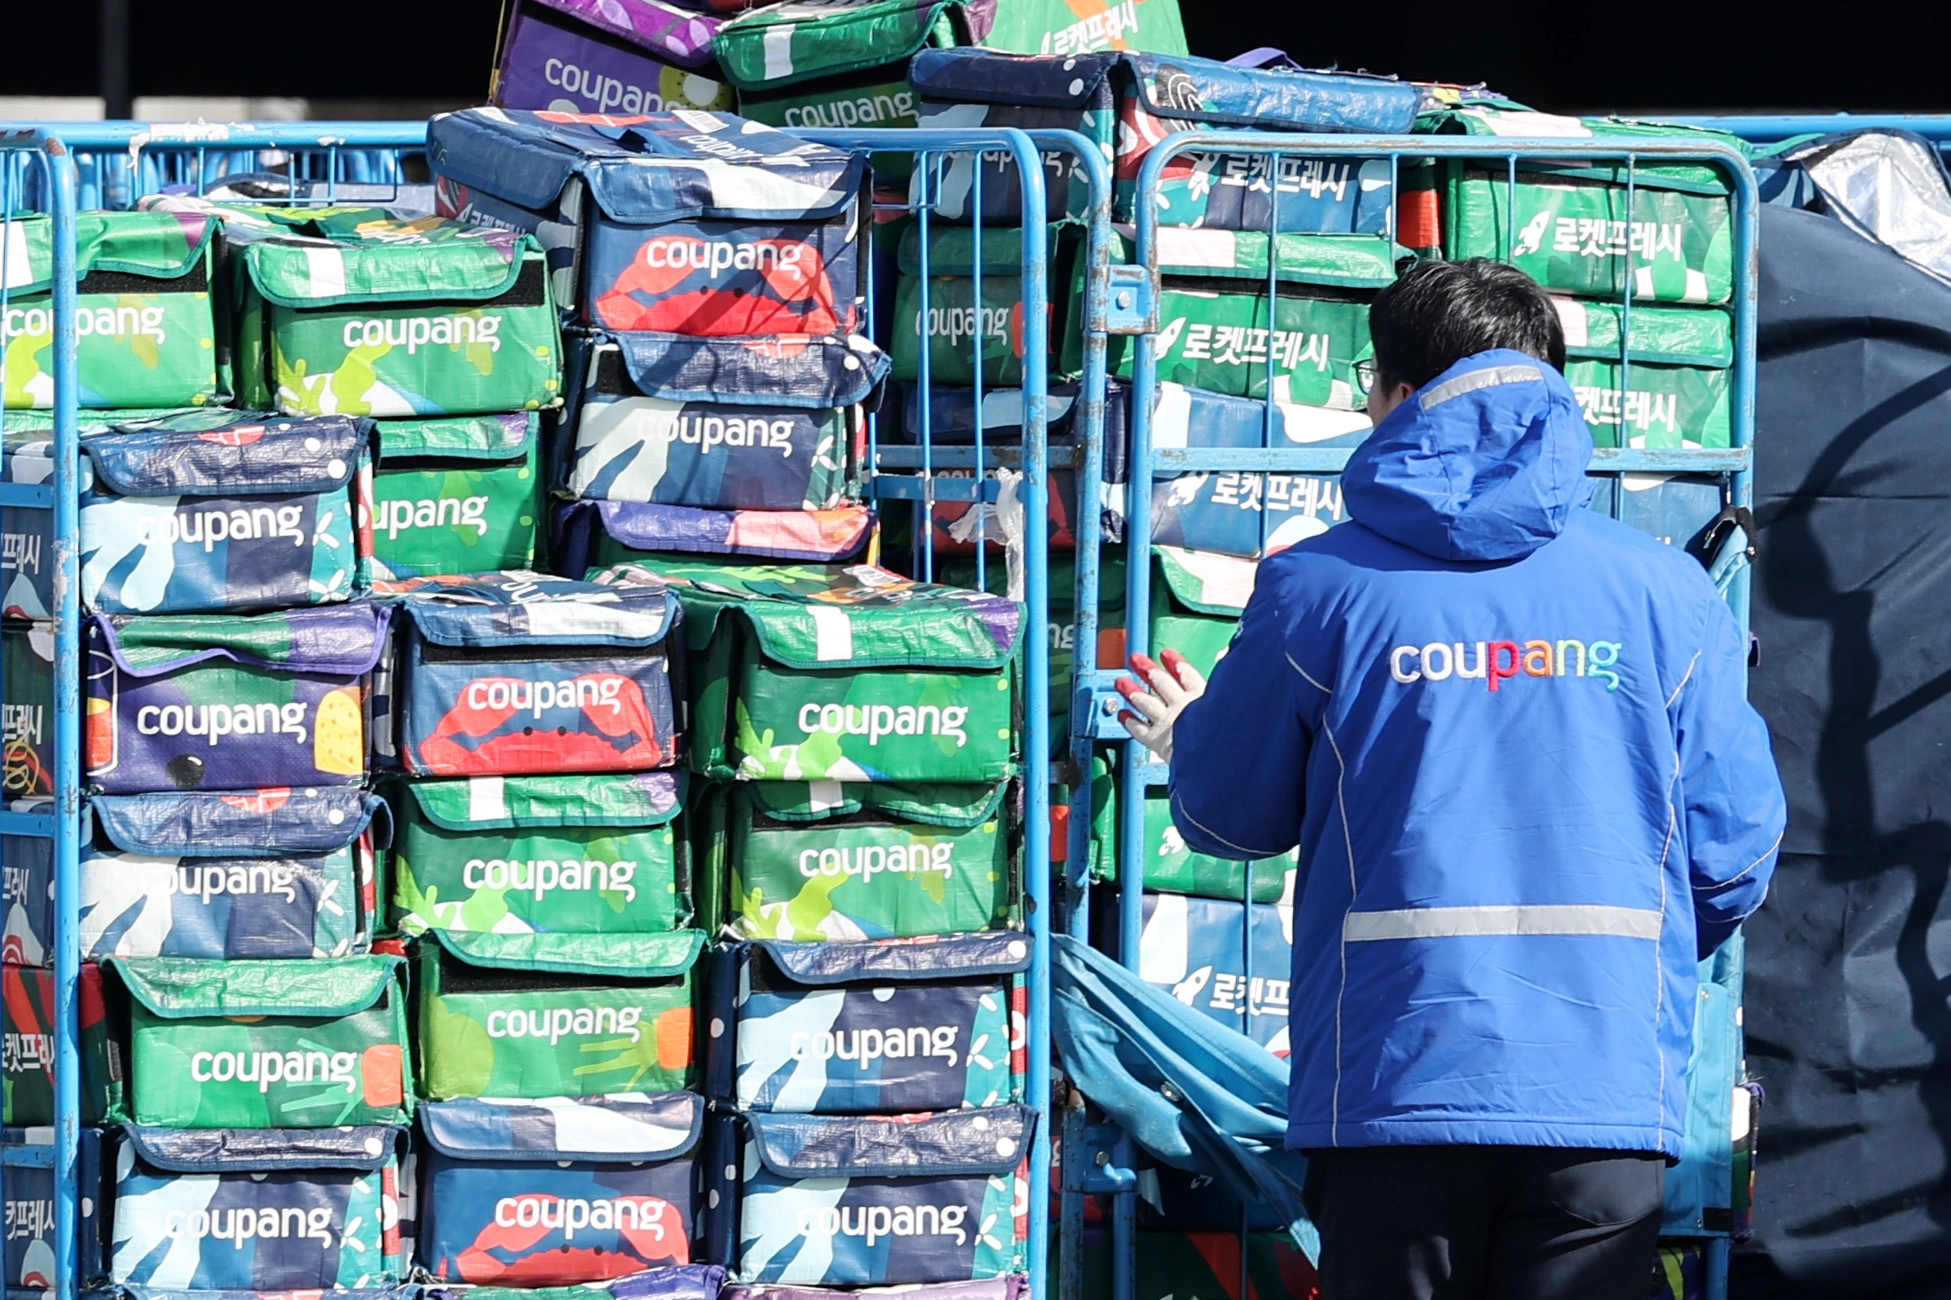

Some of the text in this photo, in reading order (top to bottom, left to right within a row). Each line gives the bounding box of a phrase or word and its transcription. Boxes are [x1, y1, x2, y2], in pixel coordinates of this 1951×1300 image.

[645, 239, 804, 281] coupang
[1553, 216, 1682, 262] 로켓프레시
[5, 306, 166, 345] copang
[343, 315, 502, 355] coupang
[1182, 323, 1330, 372] 로켓프레시
[1573, 385, 1677, 433] 켓프레시
[371, 495, 489, 541] upang
[1211, 472, 1343, 521] 로켓프레시
[137, 505, 304, 552] coupang
[1390, 638, 1623, 692] coupang
[467, 677, 624, 720] coupang
[137, 701, 308, 745] coupang
[798, 703, 969, 748] coupang
[463, 858, 637, 902] coupang
[799, 841, 955, 884] coupang
[487, 1006, 642, 1046] coupang
[789, 1024, 959, 1071] coupang
[191, 1050, 358, 1094] coupang
[163, 1206, 333, 1250] coupang
[493, 1197, 667, 1242] coupang
[796, 1204, 968, 1247] coupang
